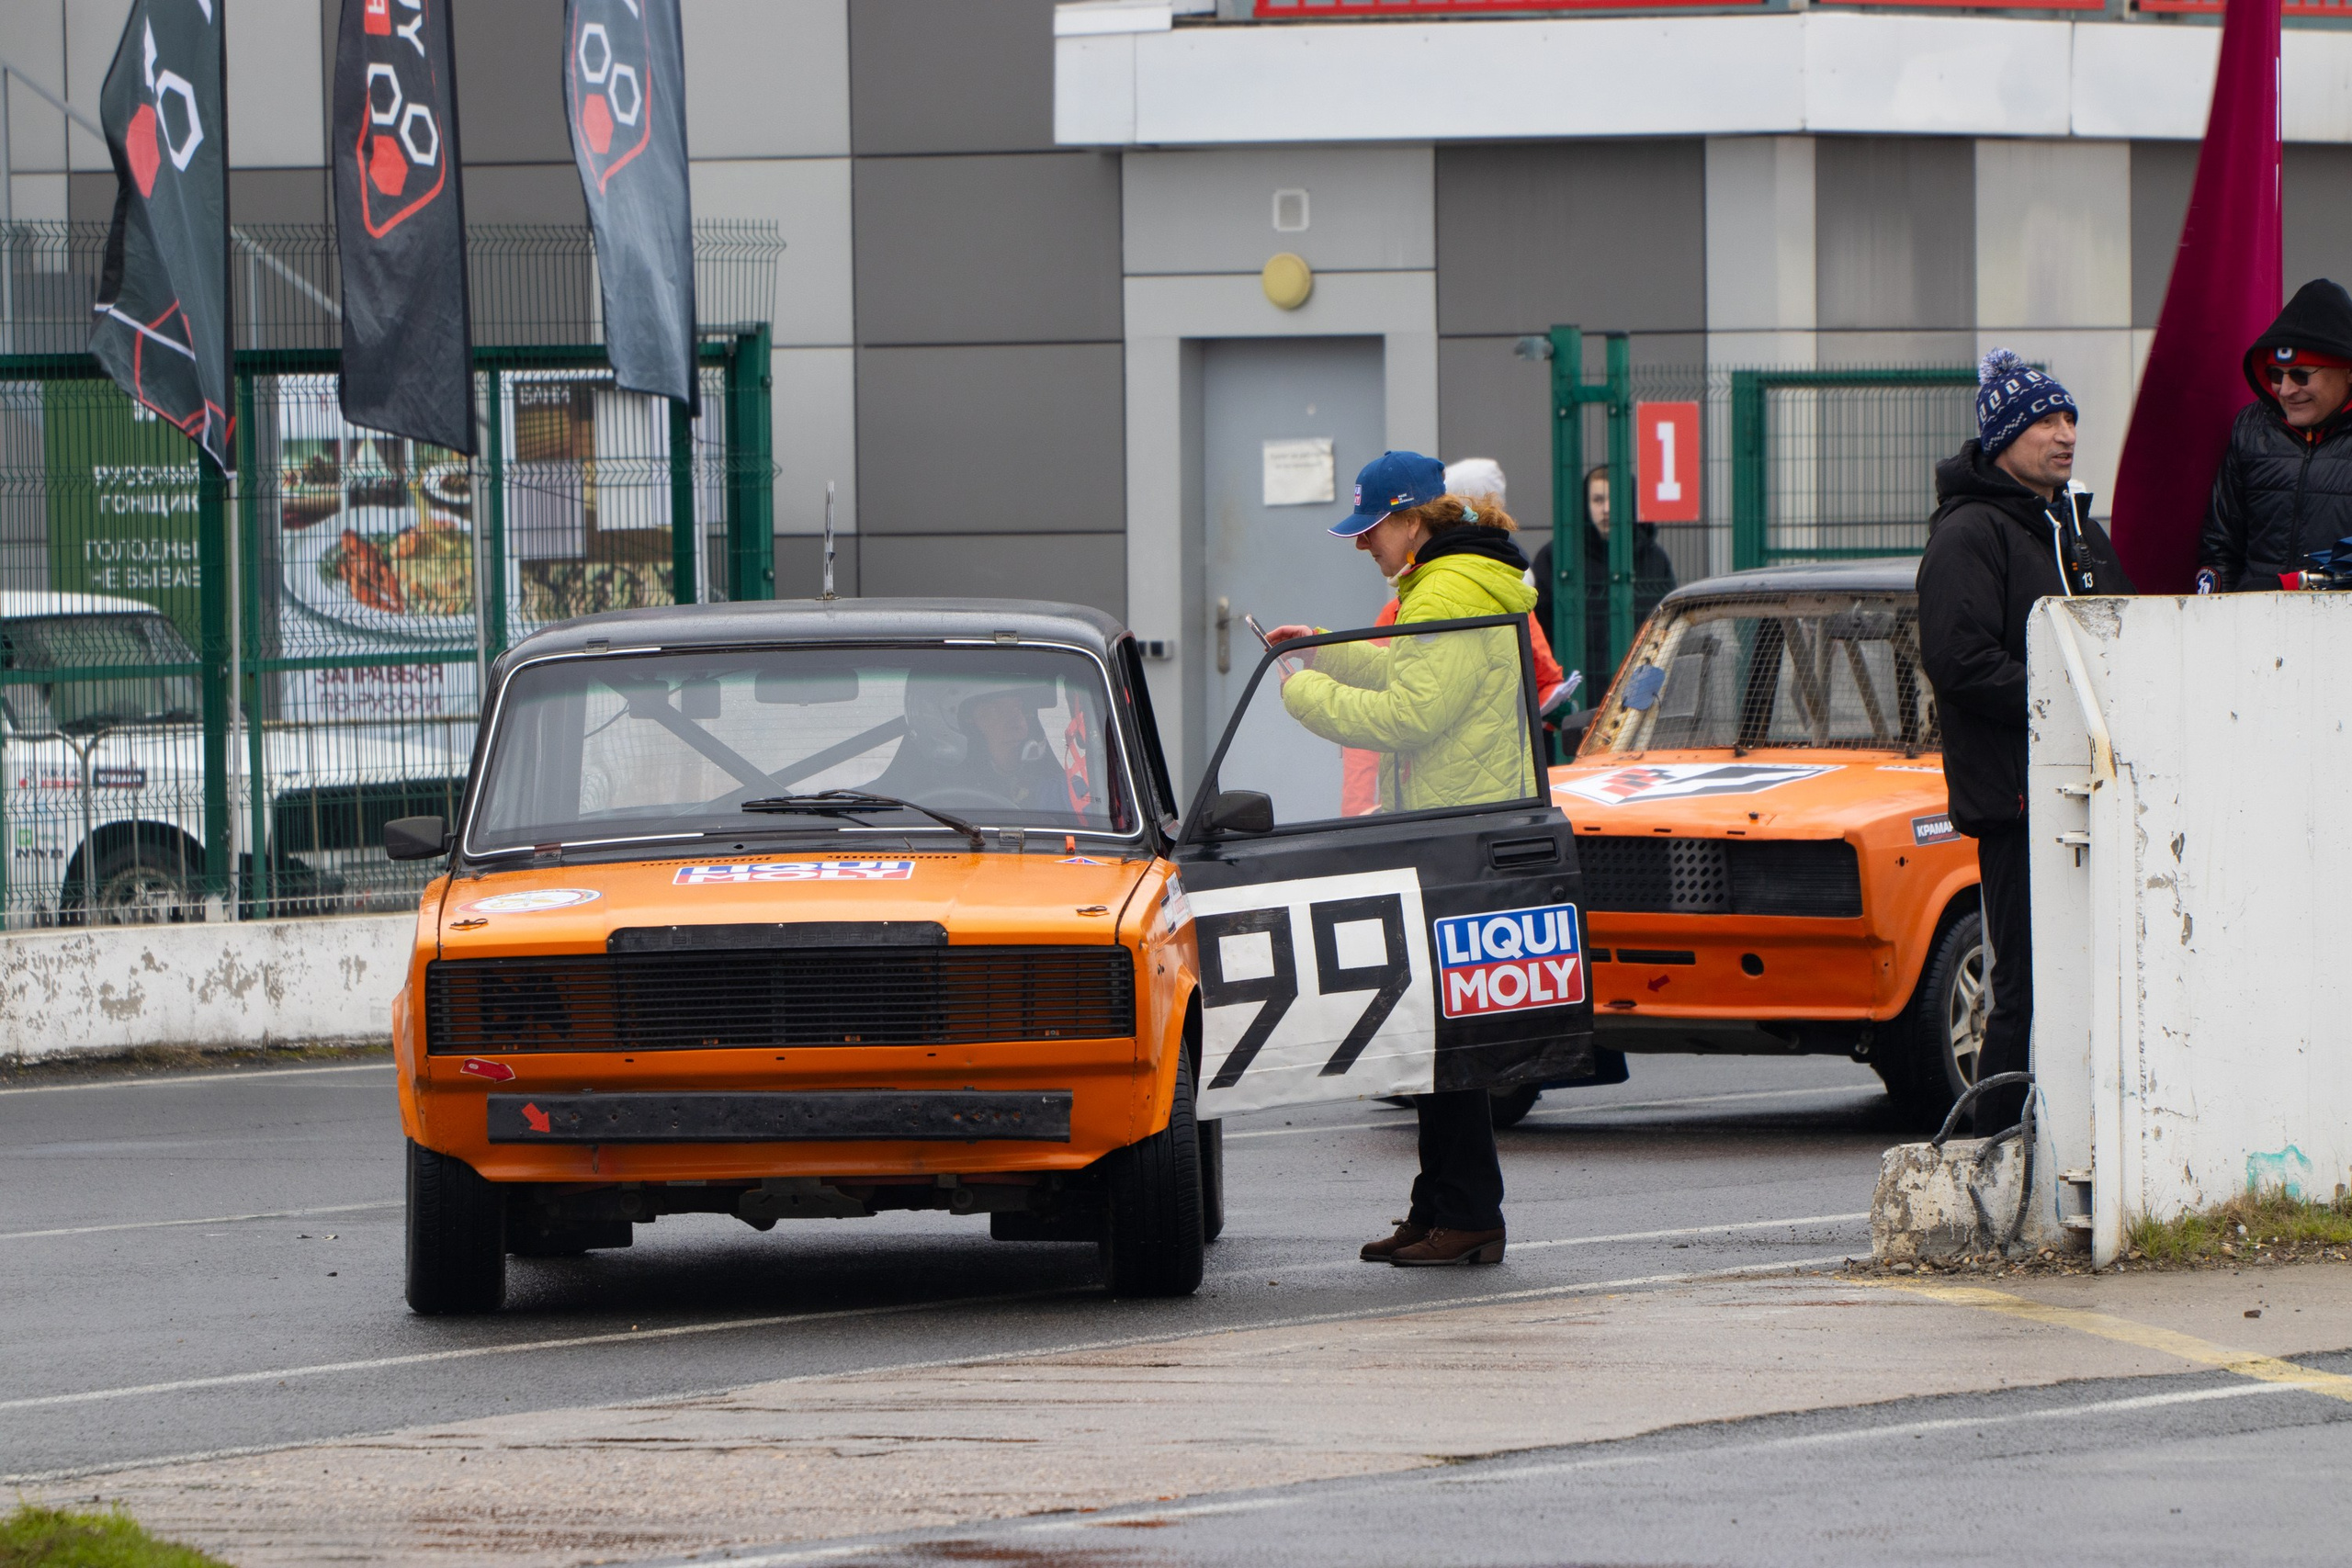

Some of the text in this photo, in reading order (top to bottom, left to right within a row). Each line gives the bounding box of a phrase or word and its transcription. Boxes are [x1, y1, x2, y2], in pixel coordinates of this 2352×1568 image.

[1657, 422, 1680, 501] 1
[100, 494, 200, 518] ГОНЩИК
[85, 539, 198, 564] ГОЛОДНЫ
[127, 565, 201, 589] БЫВАЕ
[2082, 571, 2094, 589] 13
[687, 869, 905, 884] MOLY
[691, 862, 899, 875] LIQUI
[1443, 910, 1572, 964] LIQUI
[1194, 892, 1412, 1090] 99
[1449, 957, 1578, 1012] MOLY
